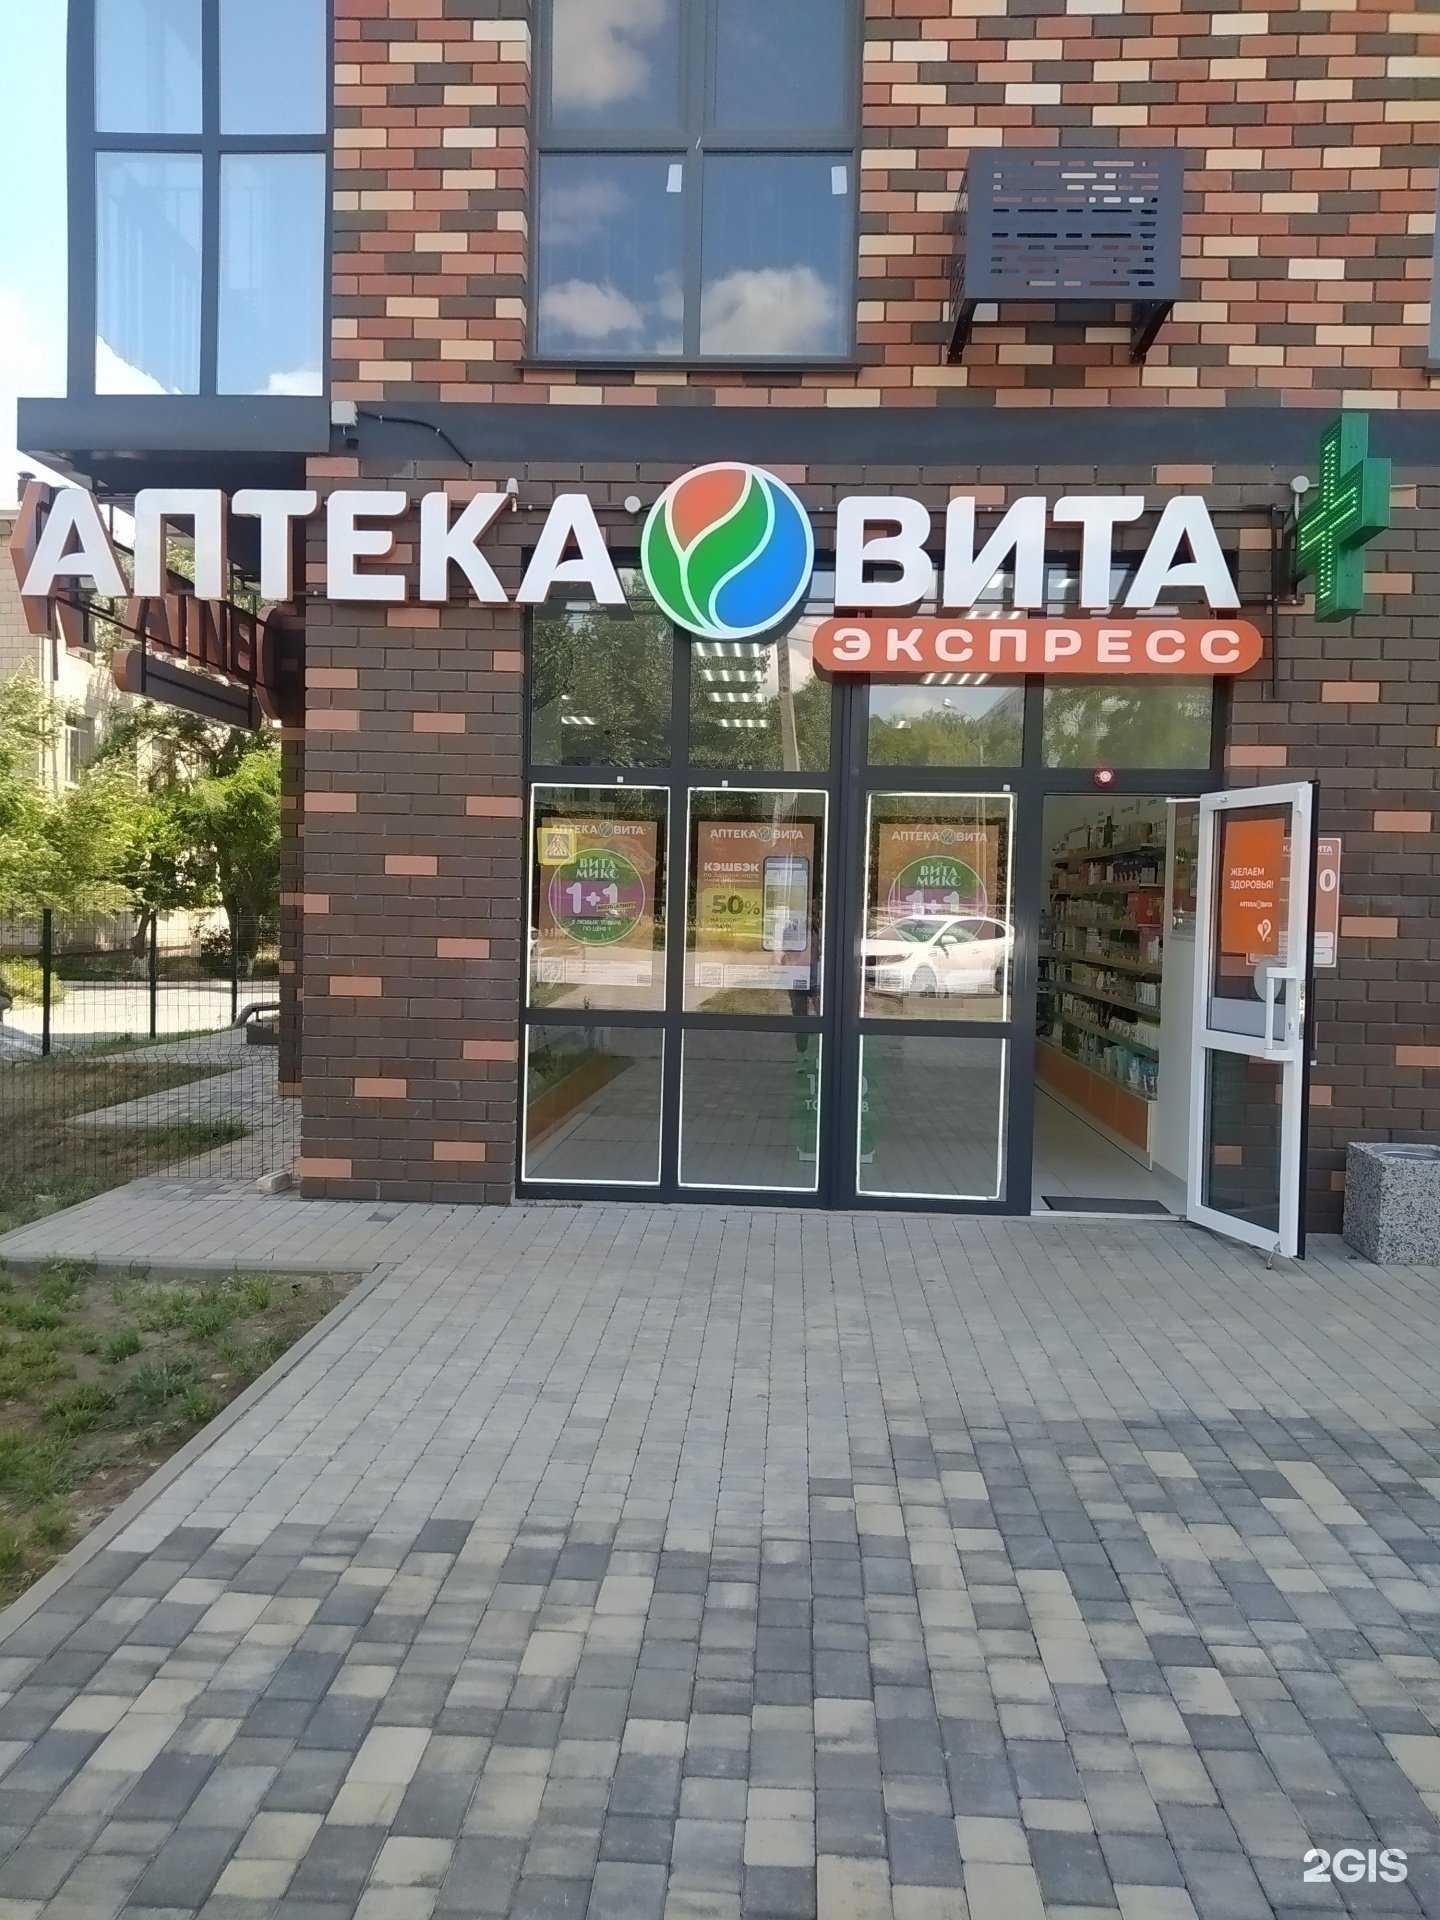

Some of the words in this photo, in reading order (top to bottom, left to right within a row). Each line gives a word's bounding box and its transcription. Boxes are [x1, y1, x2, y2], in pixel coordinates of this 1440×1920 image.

[20, 488, 627, 604] АПТЕКА
[835, 495, 1243, 609] ВИТА
[831, 628, 1241, 664] ЭКСПРЕСС
[613, 825, 645, 835] ВИТА
[710, 828, 757, 839] АПТЕКА
[773, 829, 804, 840] ВИТА
[891, 831, 940, 842] АПТЕКА
[955, 832, 988, 842] ВИТА
[579, 858, 617, 869] ВИТА
[704, 862, 760, 872] КЭШБЭК
[576, 868, 619, 879] МИКС
[919, 865, 958, 876] ВИТА
[1230, 867, 1265, 877] ЖЕЛАЕМ
[916, 875, 961, 887] МИКС
[1229, 879, 1274, 890] ЗДОРОВЬЯ!
